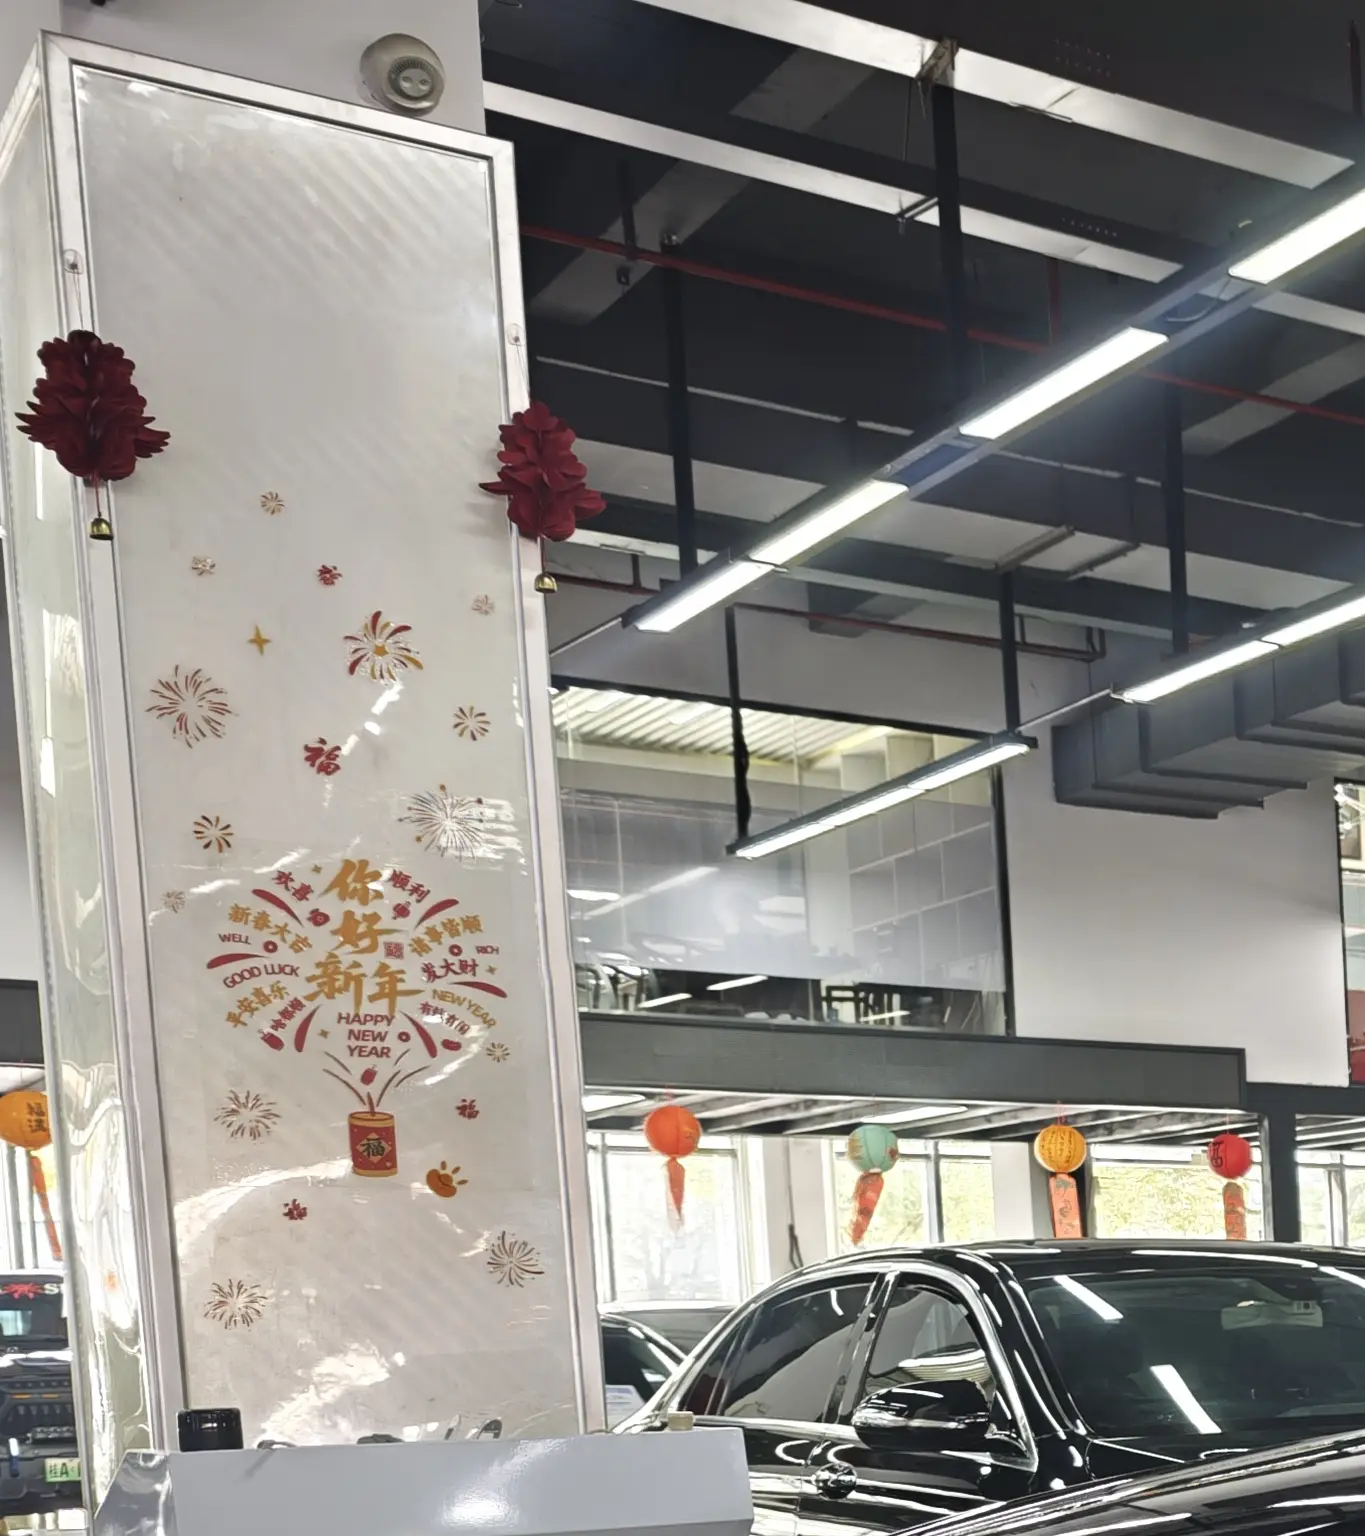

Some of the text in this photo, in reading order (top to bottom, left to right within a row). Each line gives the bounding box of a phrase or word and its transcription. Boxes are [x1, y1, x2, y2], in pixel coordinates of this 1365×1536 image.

[303, 737, 341, 776] 福
[388, 869, 431, 903] 顺利
[228, 903, 313, 954] 新春大吉
[223, 963, 300, 988] GOOD LUCK
[421, 958, 479, 983] 发大财
[303, 952, 426, 1016] 新年
[337, 1012, 395, 1027] HAPPY
[466, 1000, 497, 1028] YEAR
[348, 1029, 389, 1042] NEW
[347, 1046, 391, 1059] YEAR
[360, 1137, 385, 1158] 福
